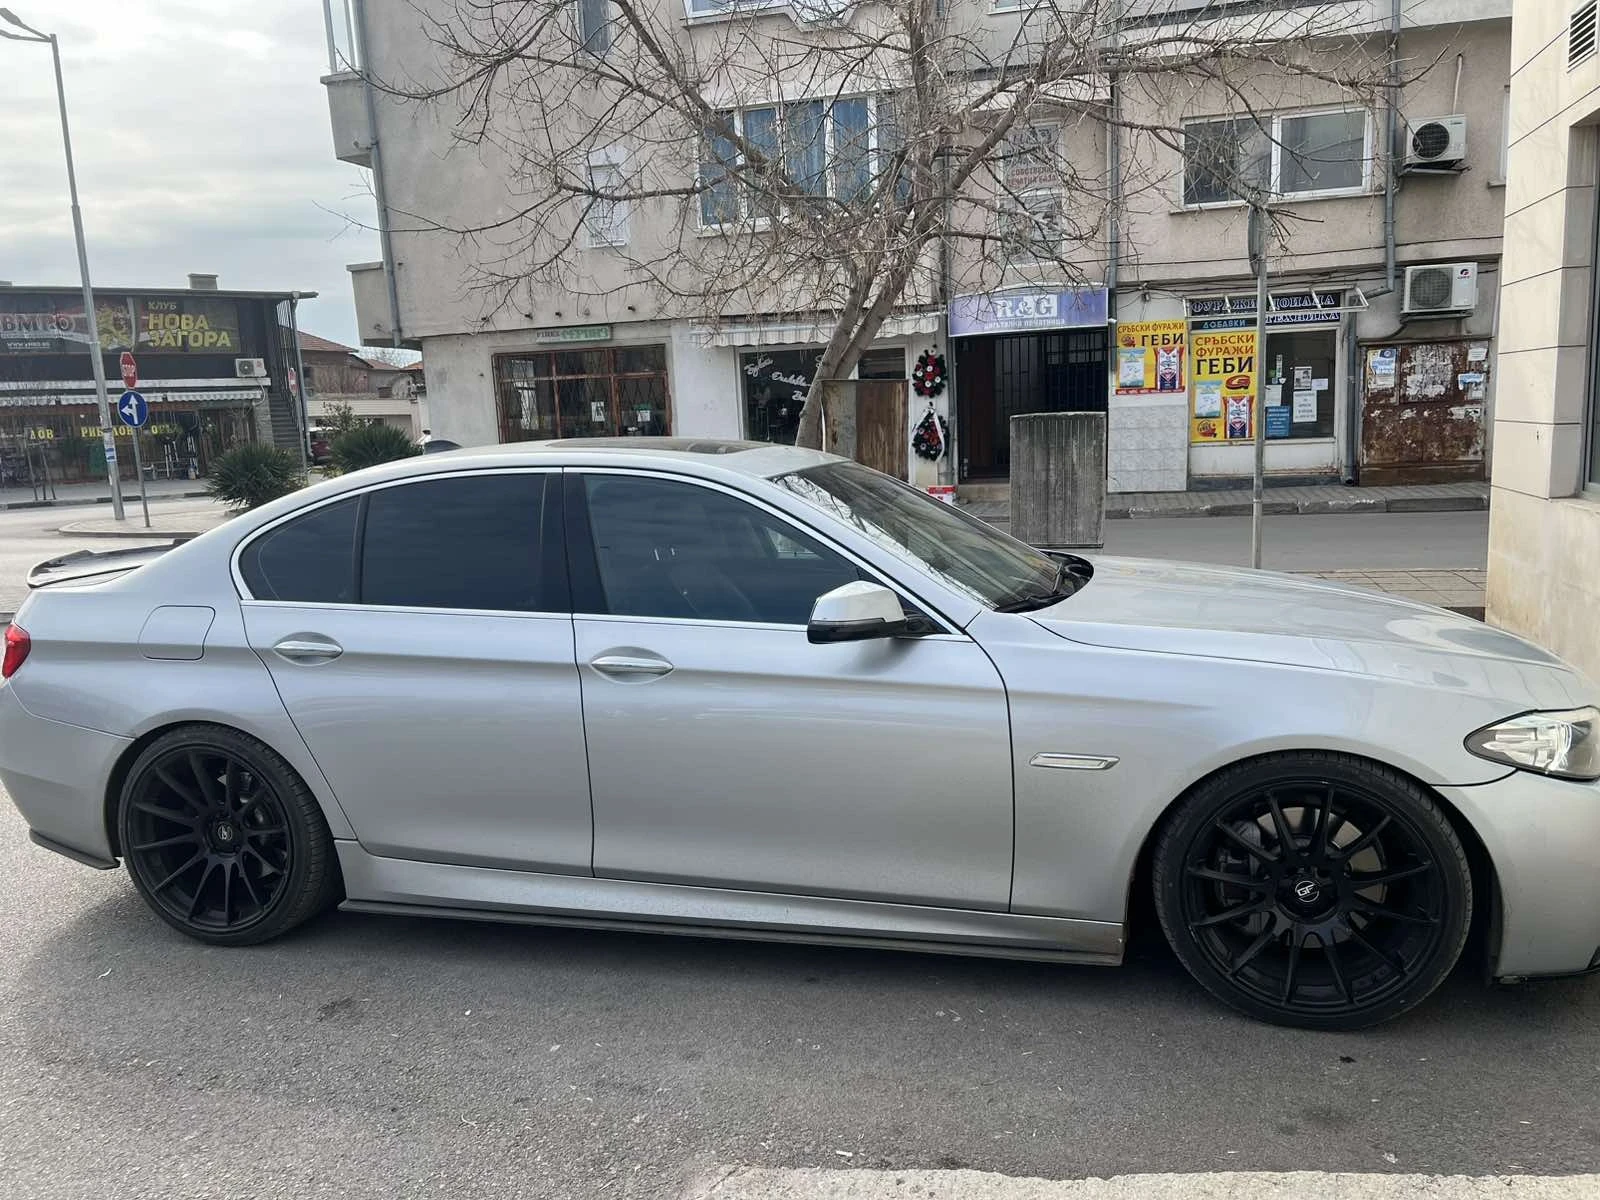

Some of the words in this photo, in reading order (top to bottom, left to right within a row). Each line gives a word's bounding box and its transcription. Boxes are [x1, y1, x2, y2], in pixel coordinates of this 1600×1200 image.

[148, 301, 177, 311] КЛУБ
[1192, 297, 1258, 313] ФУРАЖИ
[148, 313, 209, 330] НОВА
[1117, 323, 1151, 334] СРЪБСКИ
[1151, 322, 1185, 332] ФУРАЖИ
[1202, 320, 1246, 329] ДОБАВКИ
[148, 330, 232, 347] ЗАГОРА
[1141, 333, 1184, 346] ГЕБИ
[1195, 334, 1255, 346] СРЪБСКИ
[1195, 345, 1254, 358] ФУРАЖИ
[1196, 356, 1253, 375] ГЕБИ
[80, 425, 134, 438] РИБЛОВ
